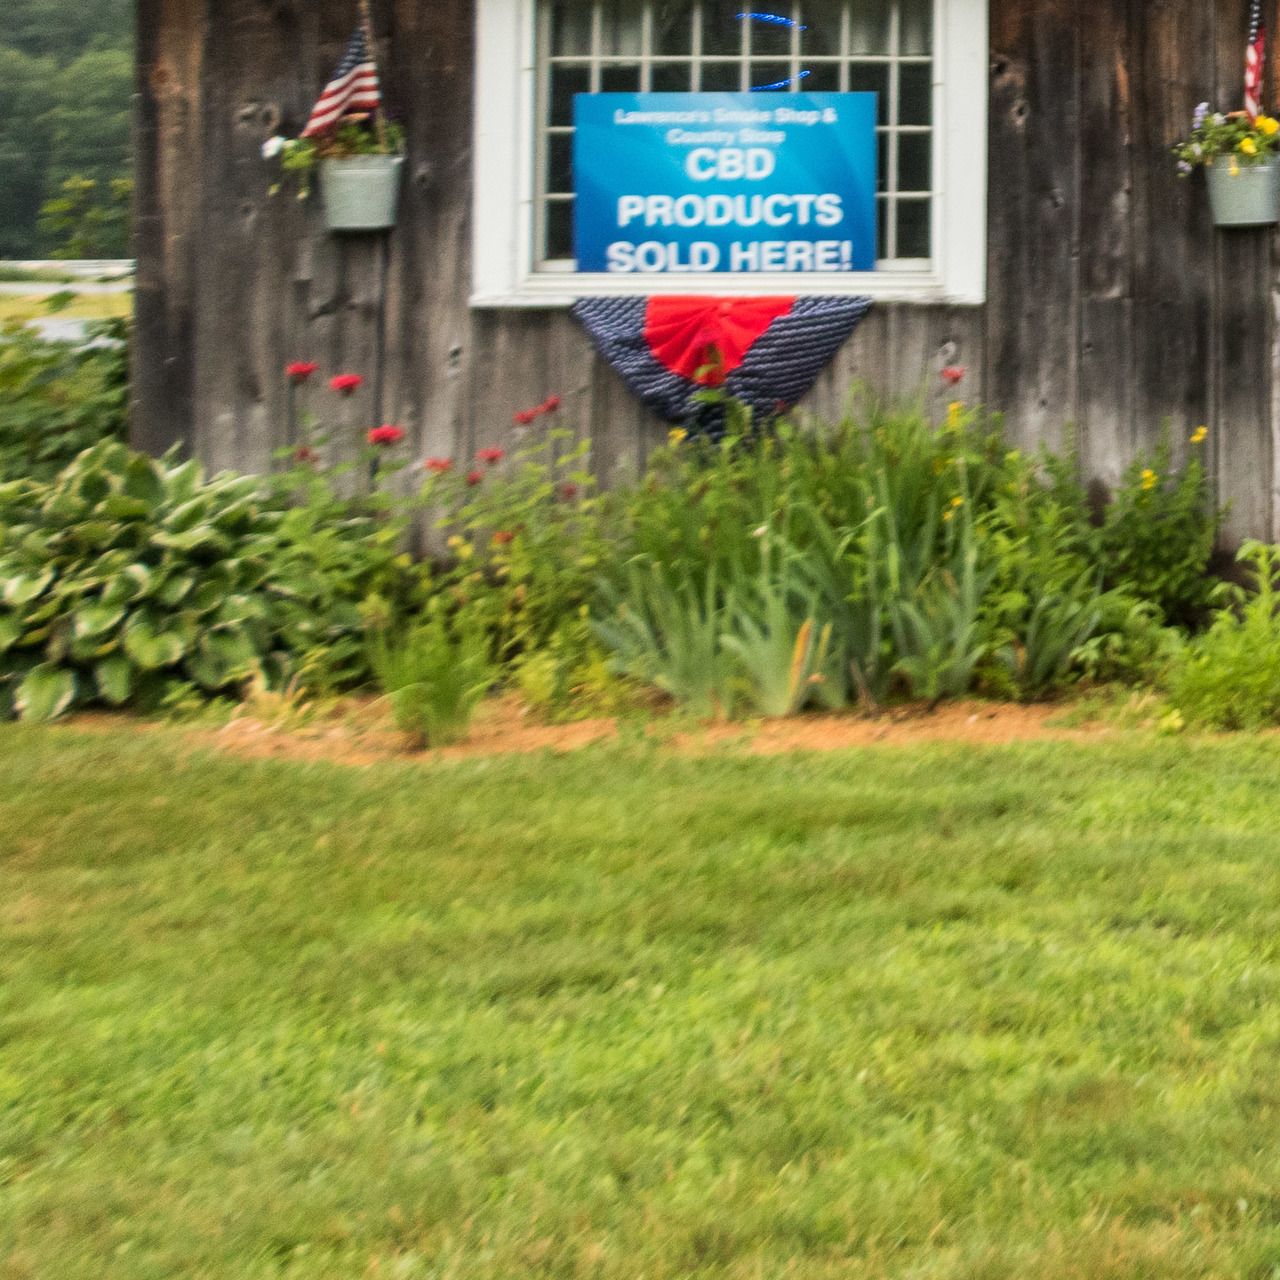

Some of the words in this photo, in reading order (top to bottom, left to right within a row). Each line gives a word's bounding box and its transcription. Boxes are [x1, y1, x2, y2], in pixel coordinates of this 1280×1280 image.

[685, 148, 776, 180] CBD
[617, 193, 844, 227] PRODUCTS
[606, 240, 720, 271] SOLD
[730, 240, 853, 271] HERE!
